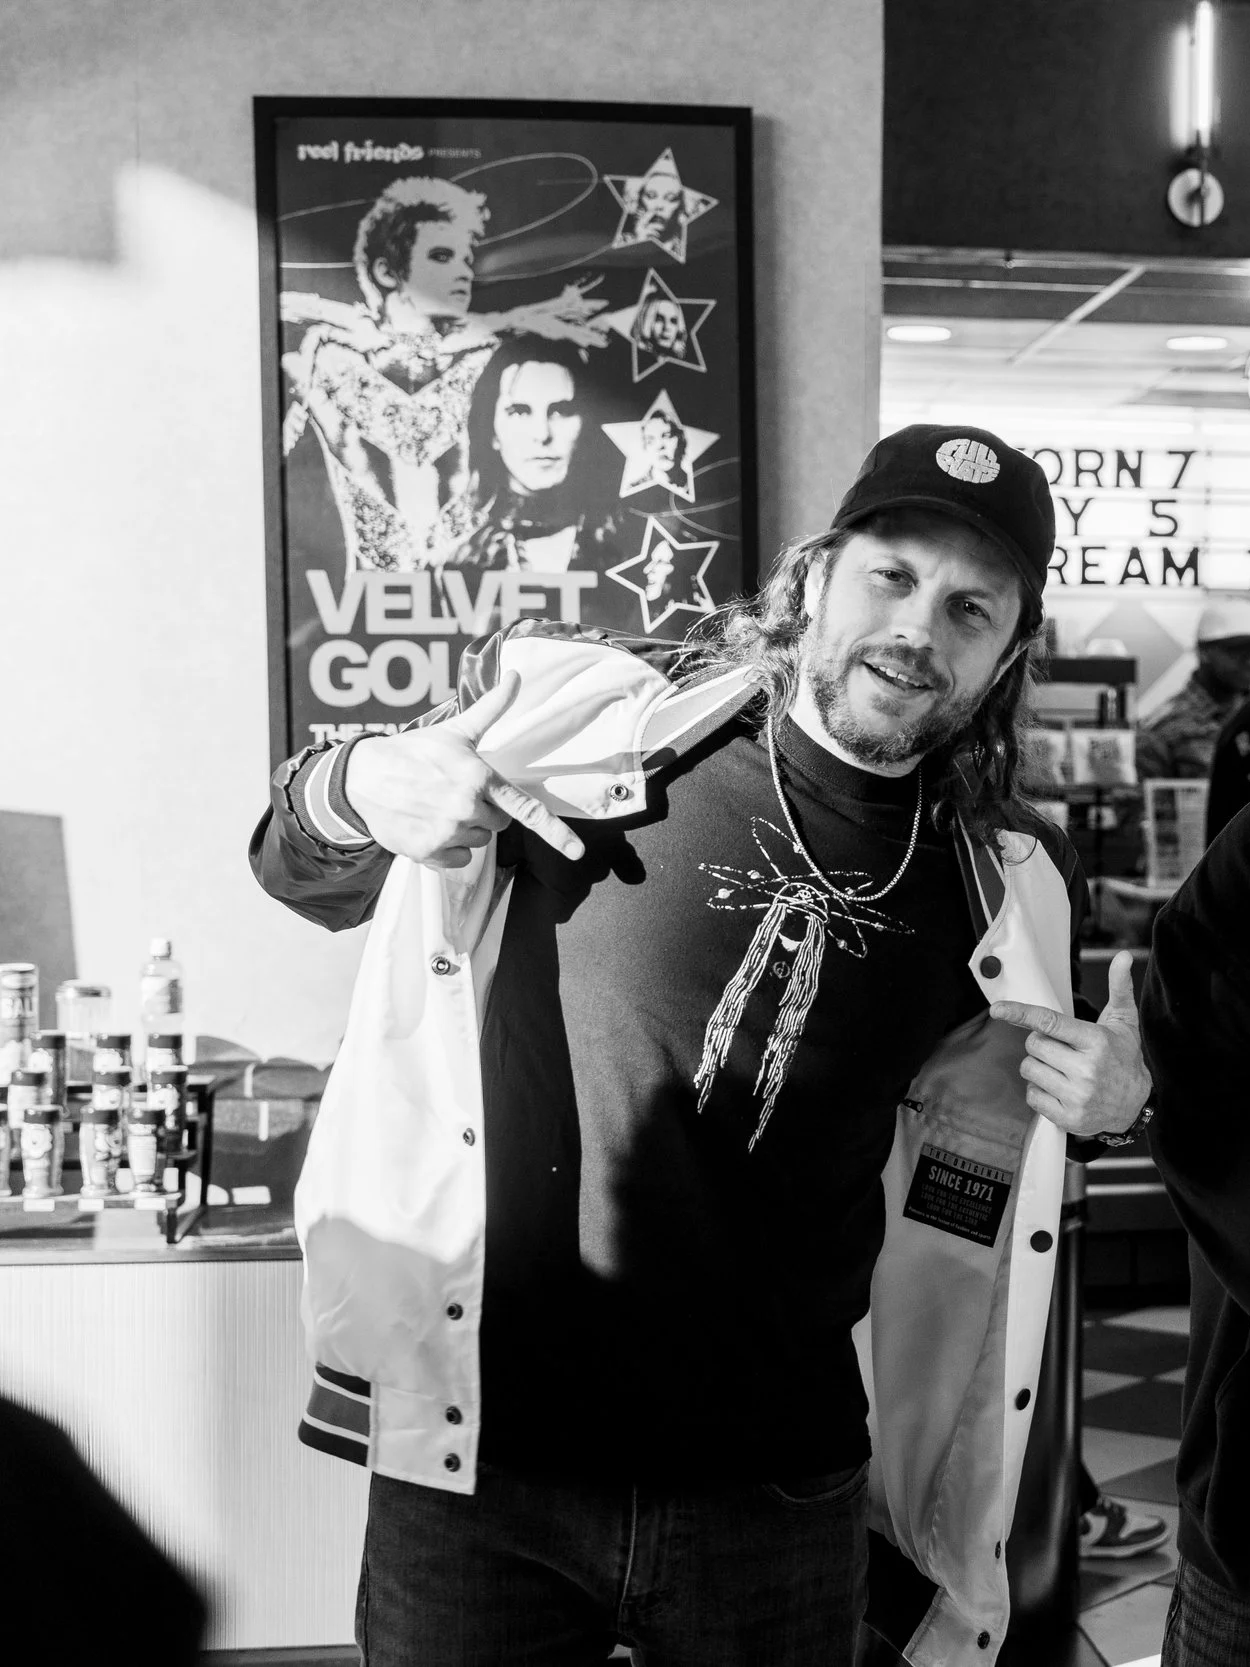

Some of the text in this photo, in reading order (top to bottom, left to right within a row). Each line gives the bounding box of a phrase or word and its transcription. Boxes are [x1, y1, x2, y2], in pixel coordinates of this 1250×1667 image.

[1017, 448, 1143, 488] ORN
[1166, 451, 1198, 488] 7
[1148, 499, 1178, 537] 5
[305, 569, 598, 635] VELVET
[928, 1165, 994, 1201] SINCE 1971
[929, 1148, 1005, 1182] THE ORIGINAL
